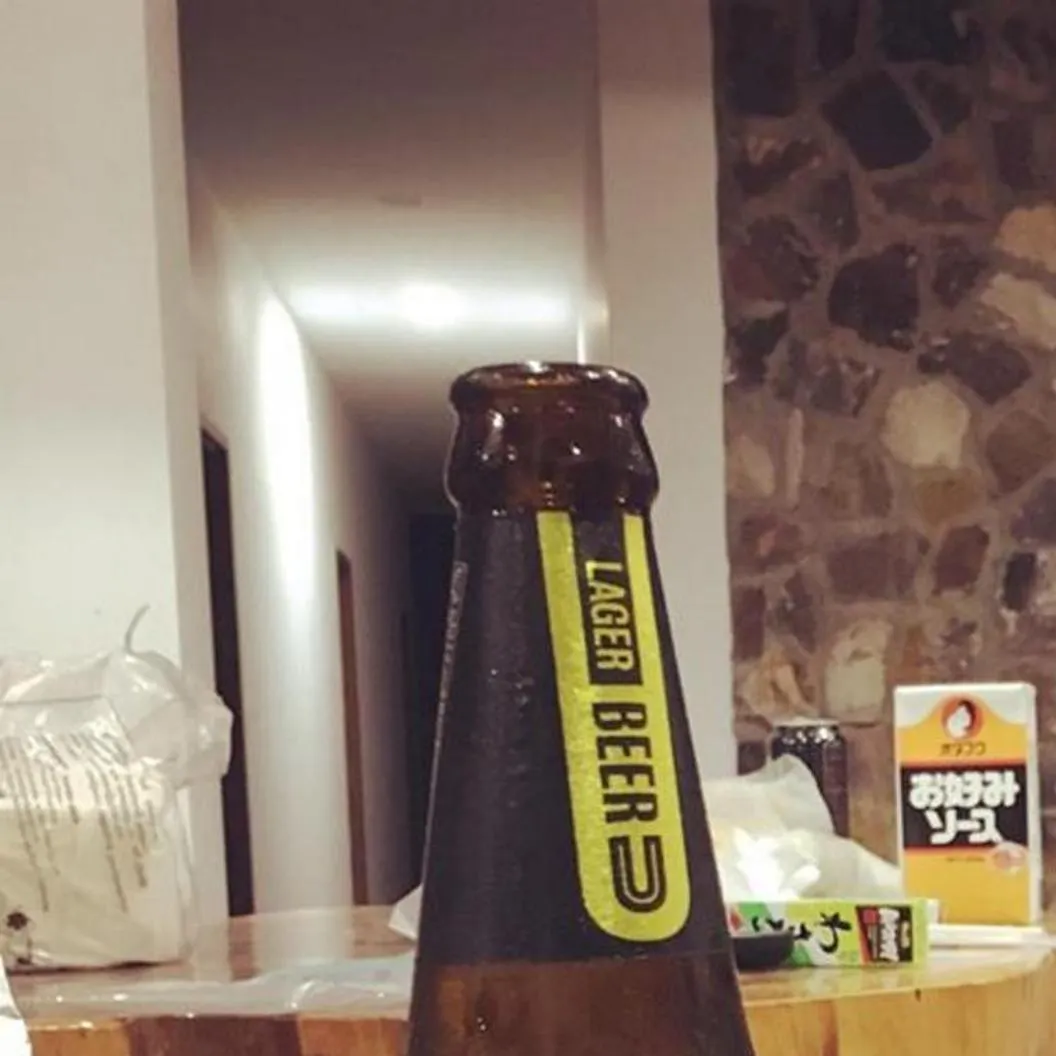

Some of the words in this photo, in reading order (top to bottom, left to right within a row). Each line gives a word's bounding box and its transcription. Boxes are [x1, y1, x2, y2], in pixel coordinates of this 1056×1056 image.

[585, 559, 635, 674] LAGER
[592, 702, 660, 825] BEER
[909, 770, 1020, 810] お好み
[925, 808, 1003, 844] ソース
